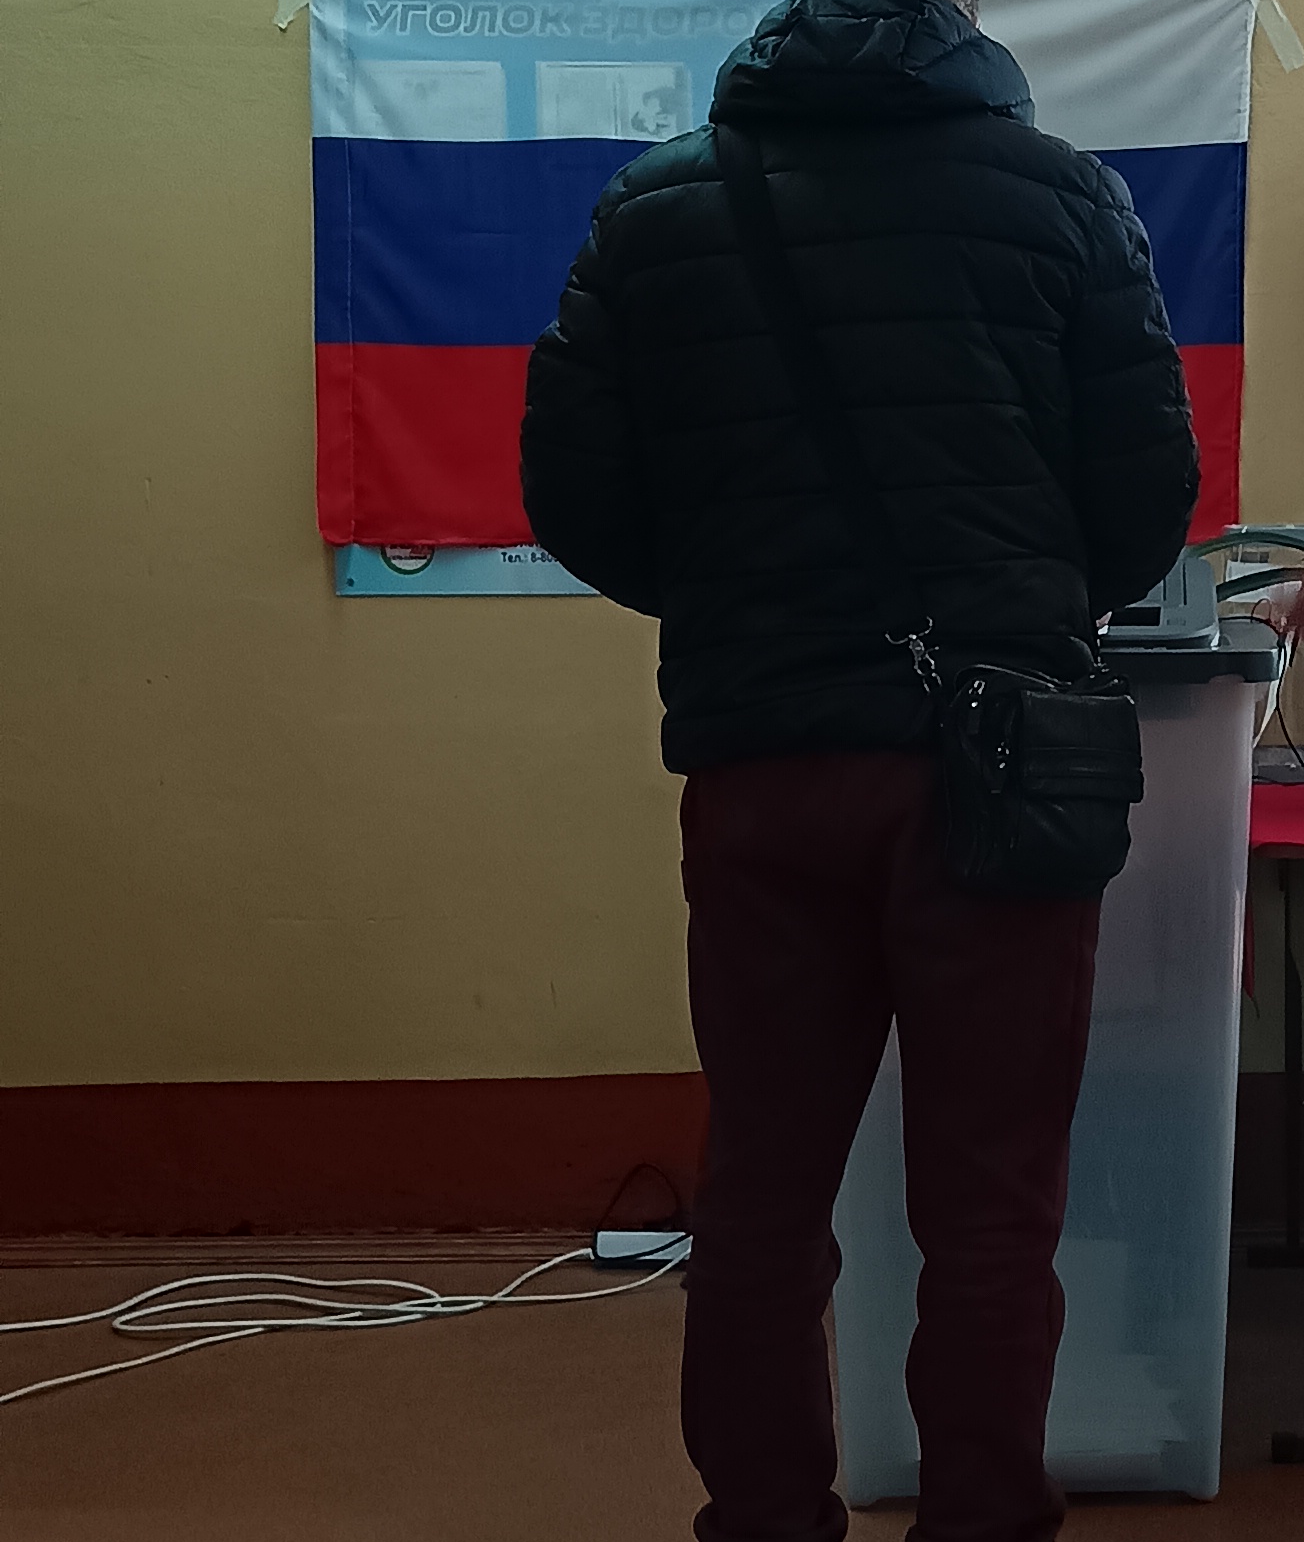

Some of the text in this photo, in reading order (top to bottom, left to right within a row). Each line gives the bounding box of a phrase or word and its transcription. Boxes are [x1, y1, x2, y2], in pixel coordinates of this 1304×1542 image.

[365, 0, 756, 43] УГОЛОК ЗДОРО
[530, 551, 559, 563] 8-80
